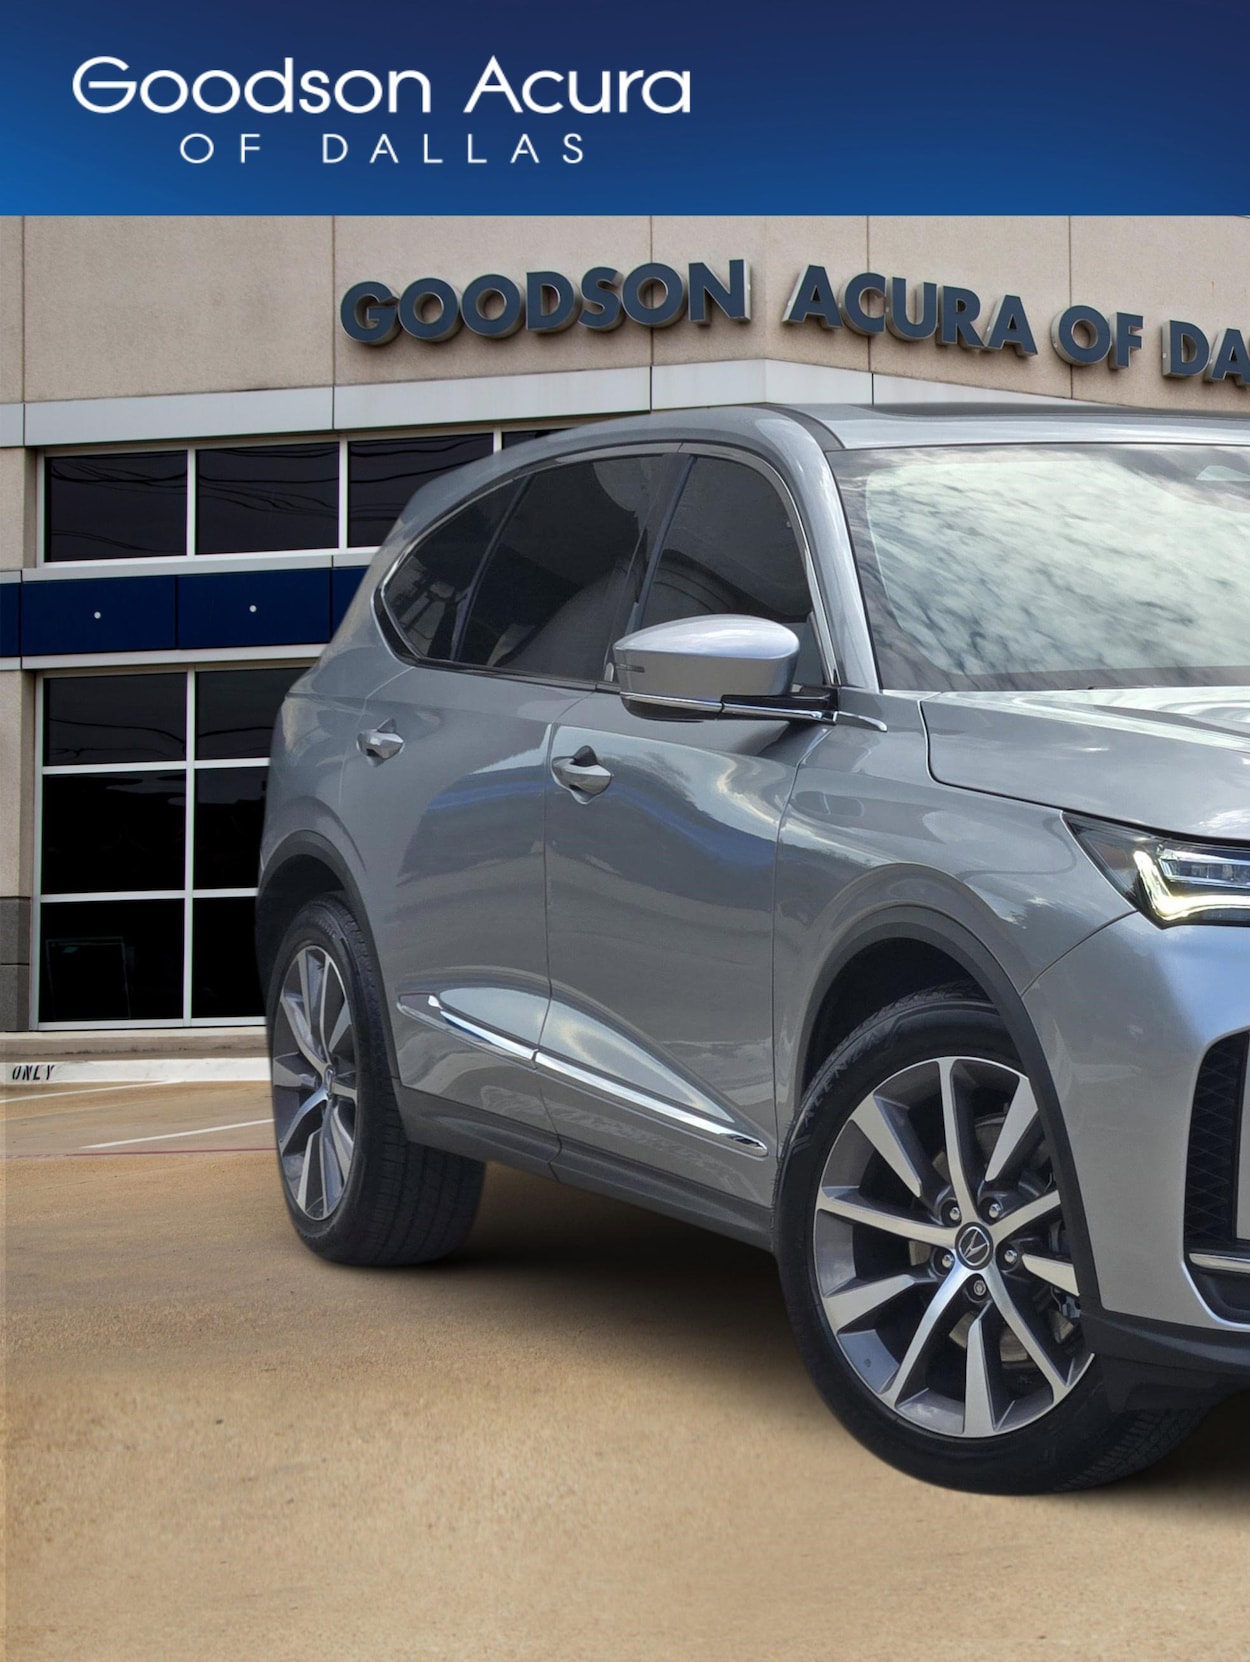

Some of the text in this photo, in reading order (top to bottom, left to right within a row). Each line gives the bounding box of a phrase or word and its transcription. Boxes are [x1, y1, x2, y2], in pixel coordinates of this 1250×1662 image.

[340, 259, 751, 345] GOODSON
[782, 264, 1038, 356] ACURA
[1051, 305, 1144, 369] OF
[12, 1064, 56, 1081] ONLY
